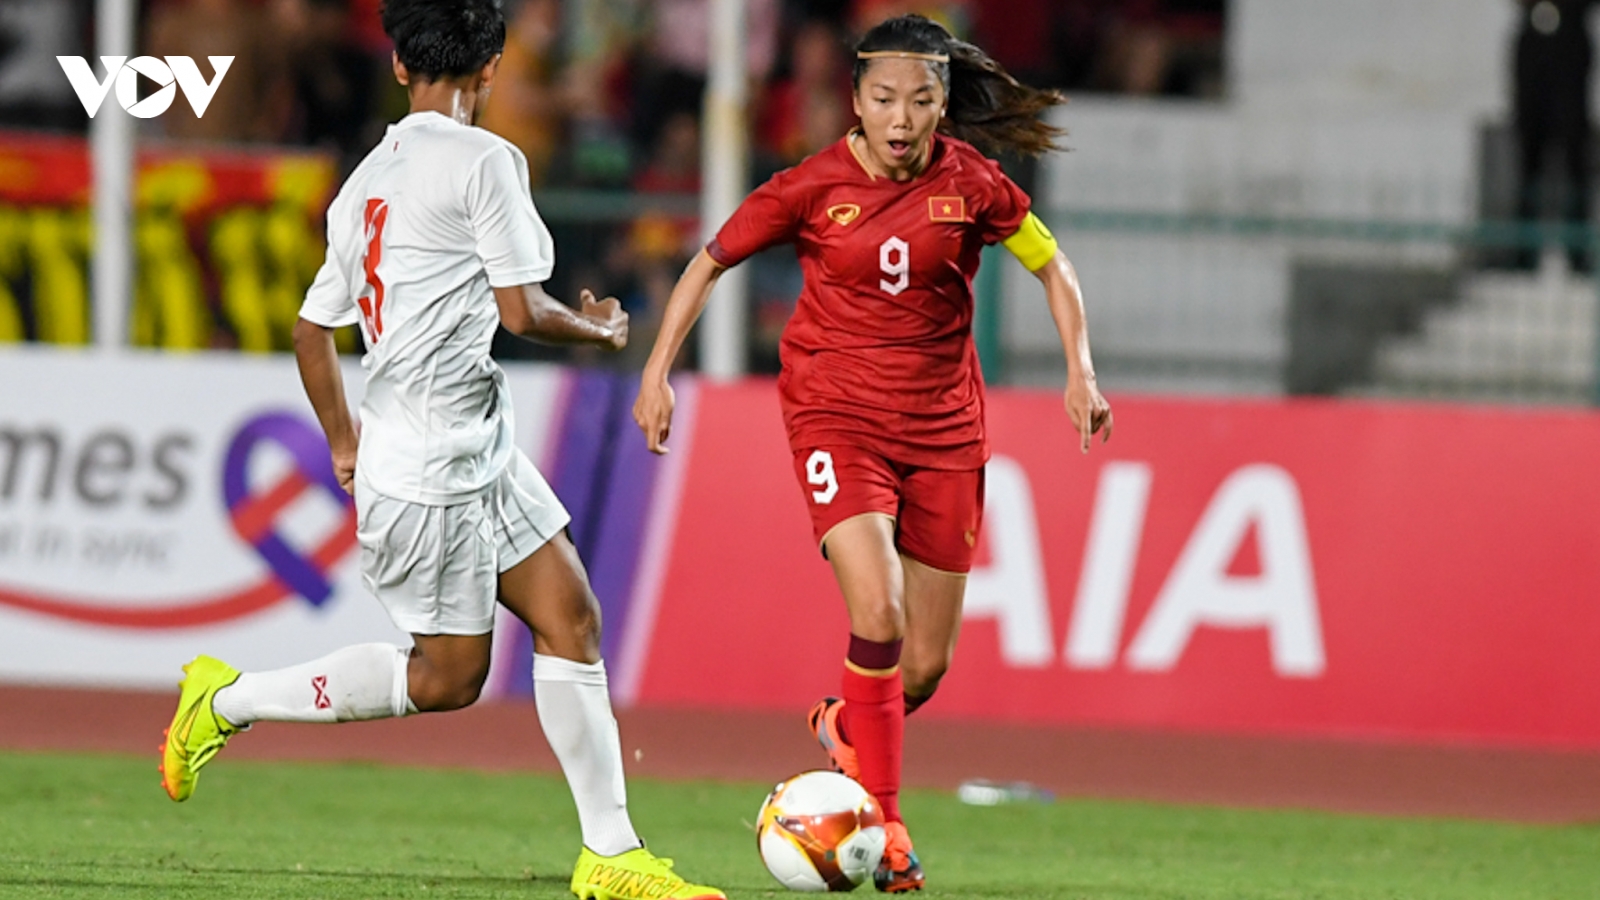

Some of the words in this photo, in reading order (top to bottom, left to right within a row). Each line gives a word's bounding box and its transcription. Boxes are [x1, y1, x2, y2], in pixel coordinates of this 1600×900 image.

[879, 235, 910, 296] 9
[805, 449, 839, 504] 9
[963, 454, 1327, 678] AIA
